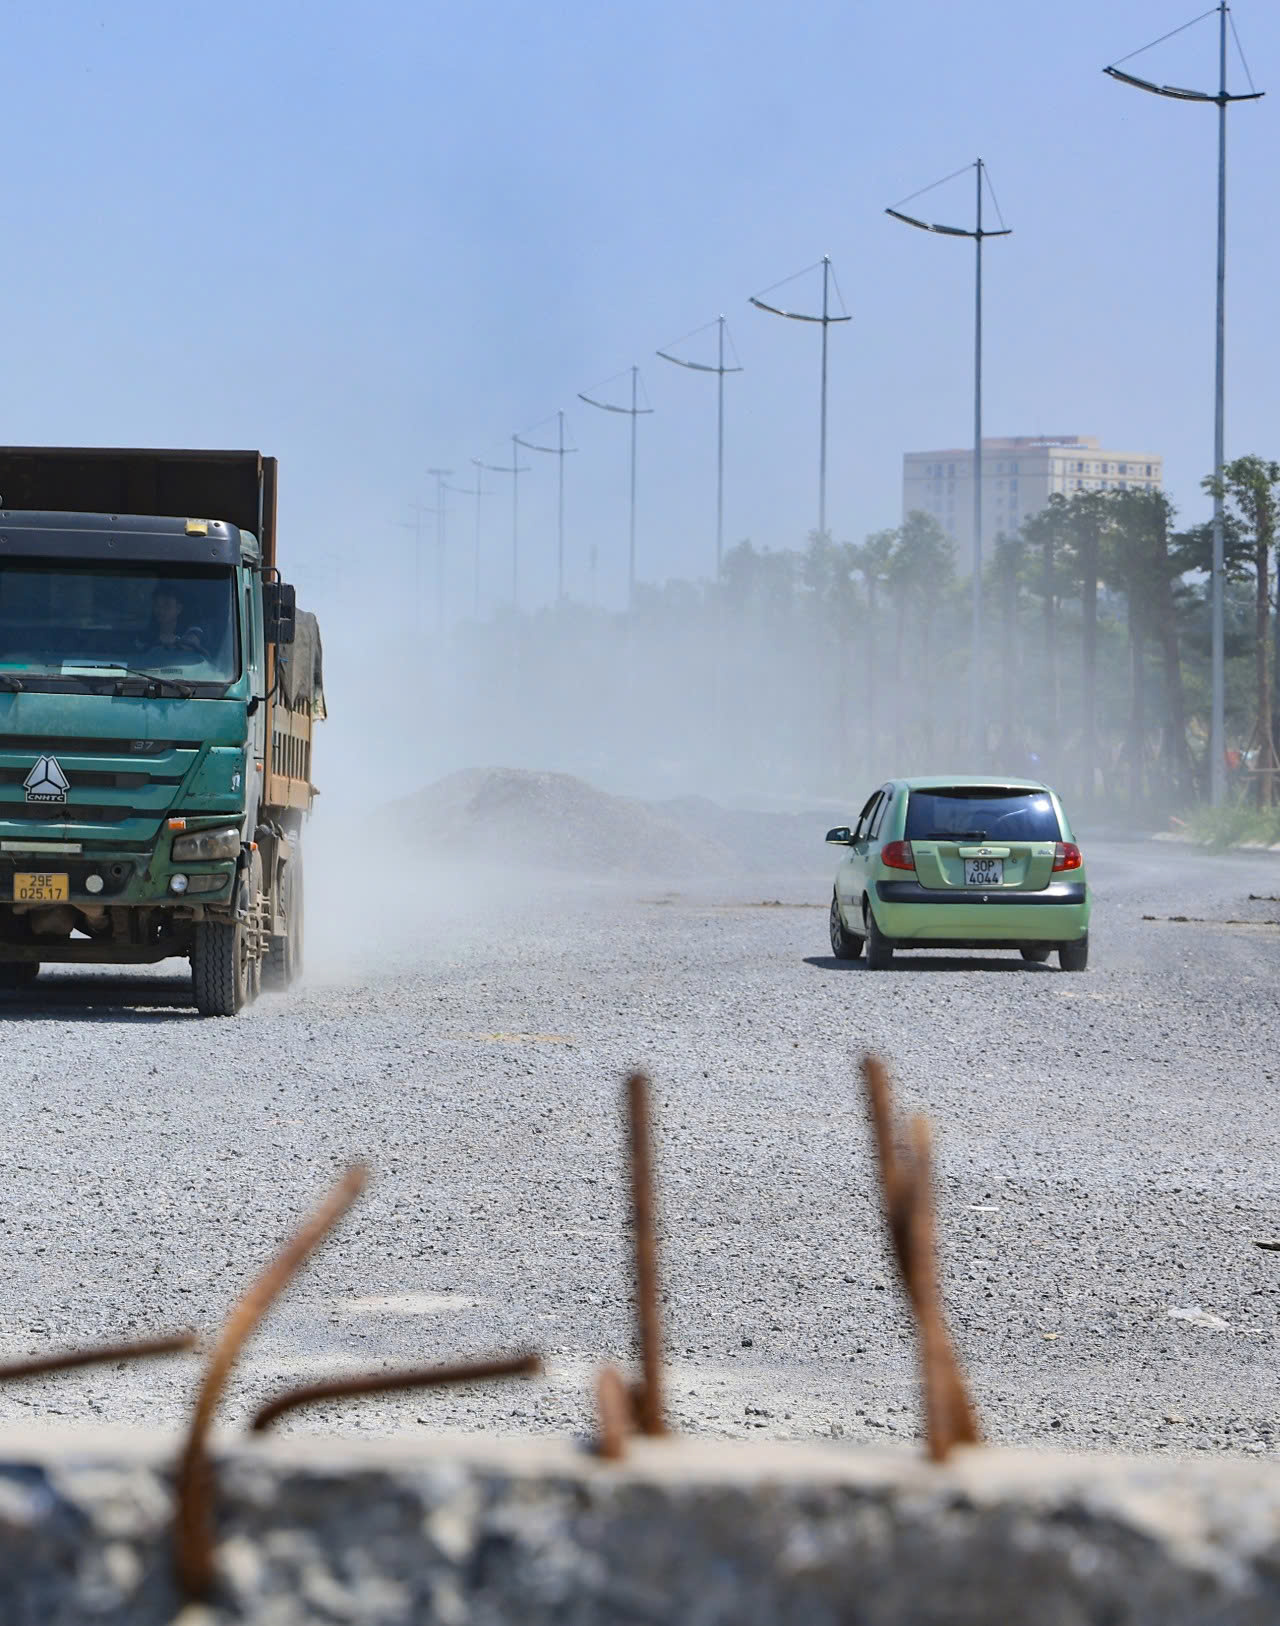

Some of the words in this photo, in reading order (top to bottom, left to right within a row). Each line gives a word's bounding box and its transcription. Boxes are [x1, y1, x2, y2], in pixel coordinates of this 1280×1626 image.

[28, 794, 64, 802] CNHTC
[972, 860, 995, 872] 30P
[30, 875, 53, 887] 29E
[969, 872, 999, 884] 4044
[20, 888, 62, 900] 025.17
